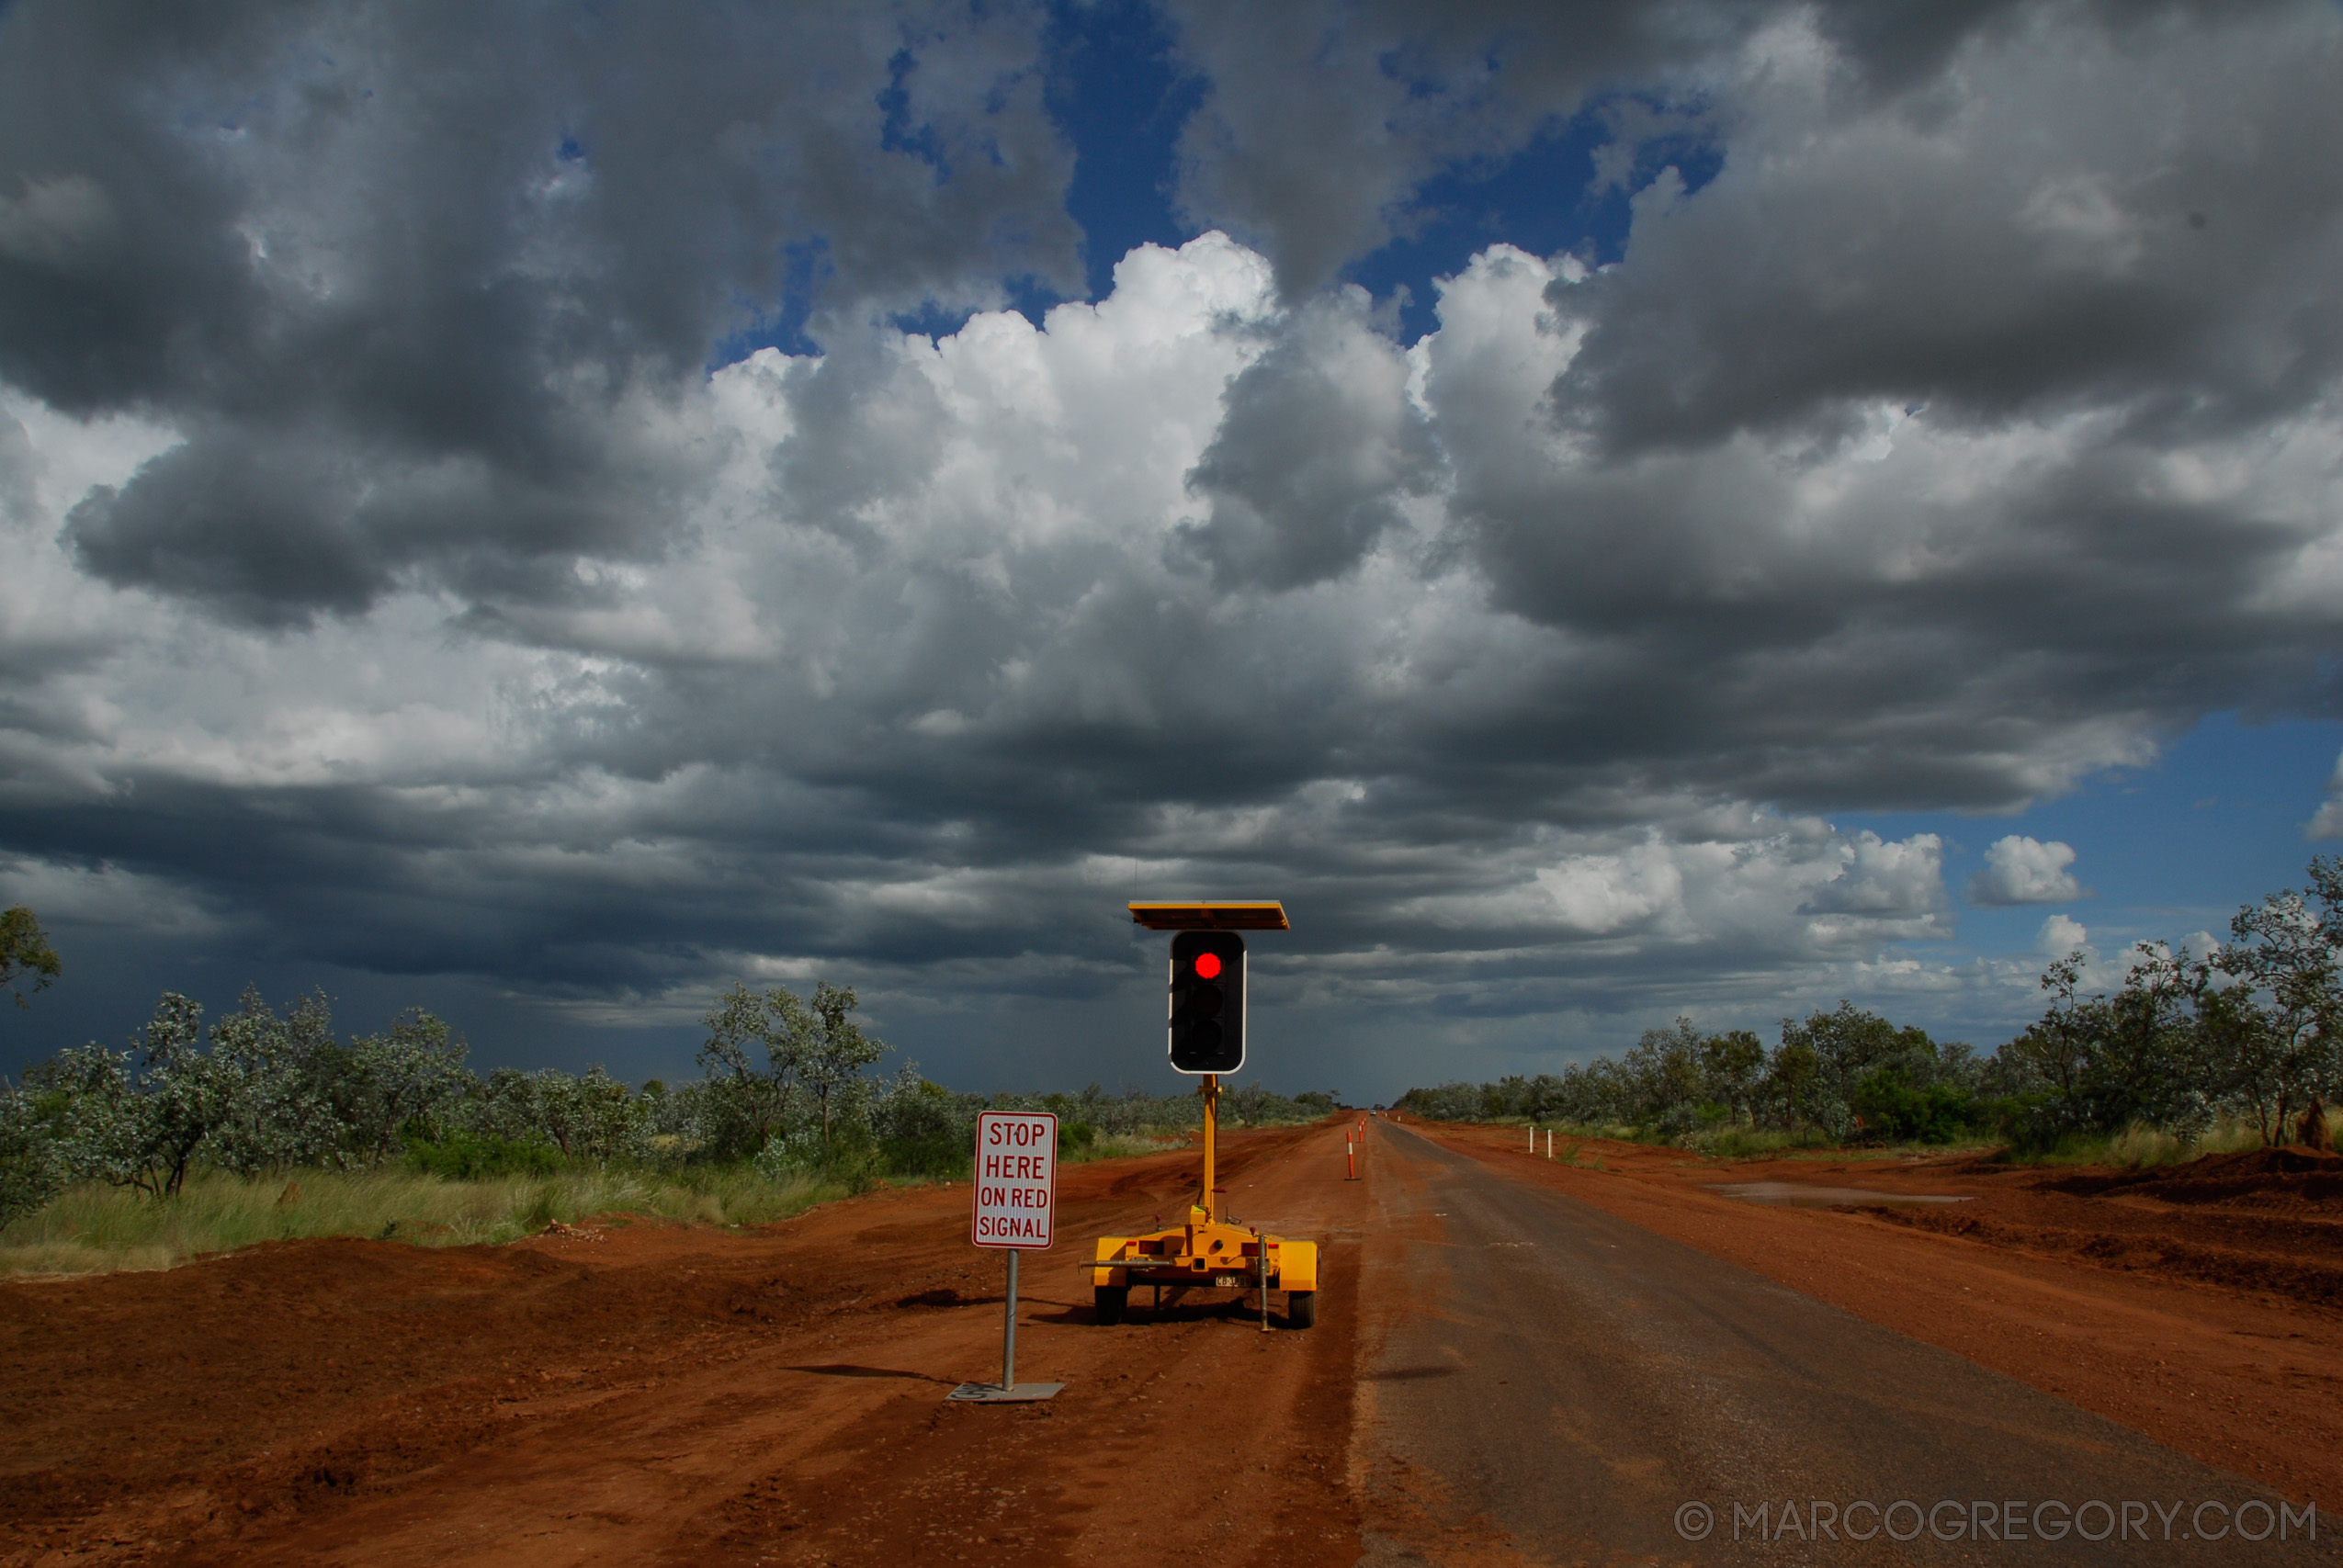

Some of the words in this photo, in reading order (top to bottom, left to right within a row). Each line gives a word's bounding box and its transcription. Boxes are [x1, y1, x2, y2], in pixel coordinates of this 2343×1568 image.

[990, 1122, 1045, 1146] STOP
[986, 1155, 1045, 1179] HERE
[980, 1187, 1005, 1206] ON
[1012, 1188, 1047, 1208] RED
[979, 1216, 1047, 1238] SIGNAL
